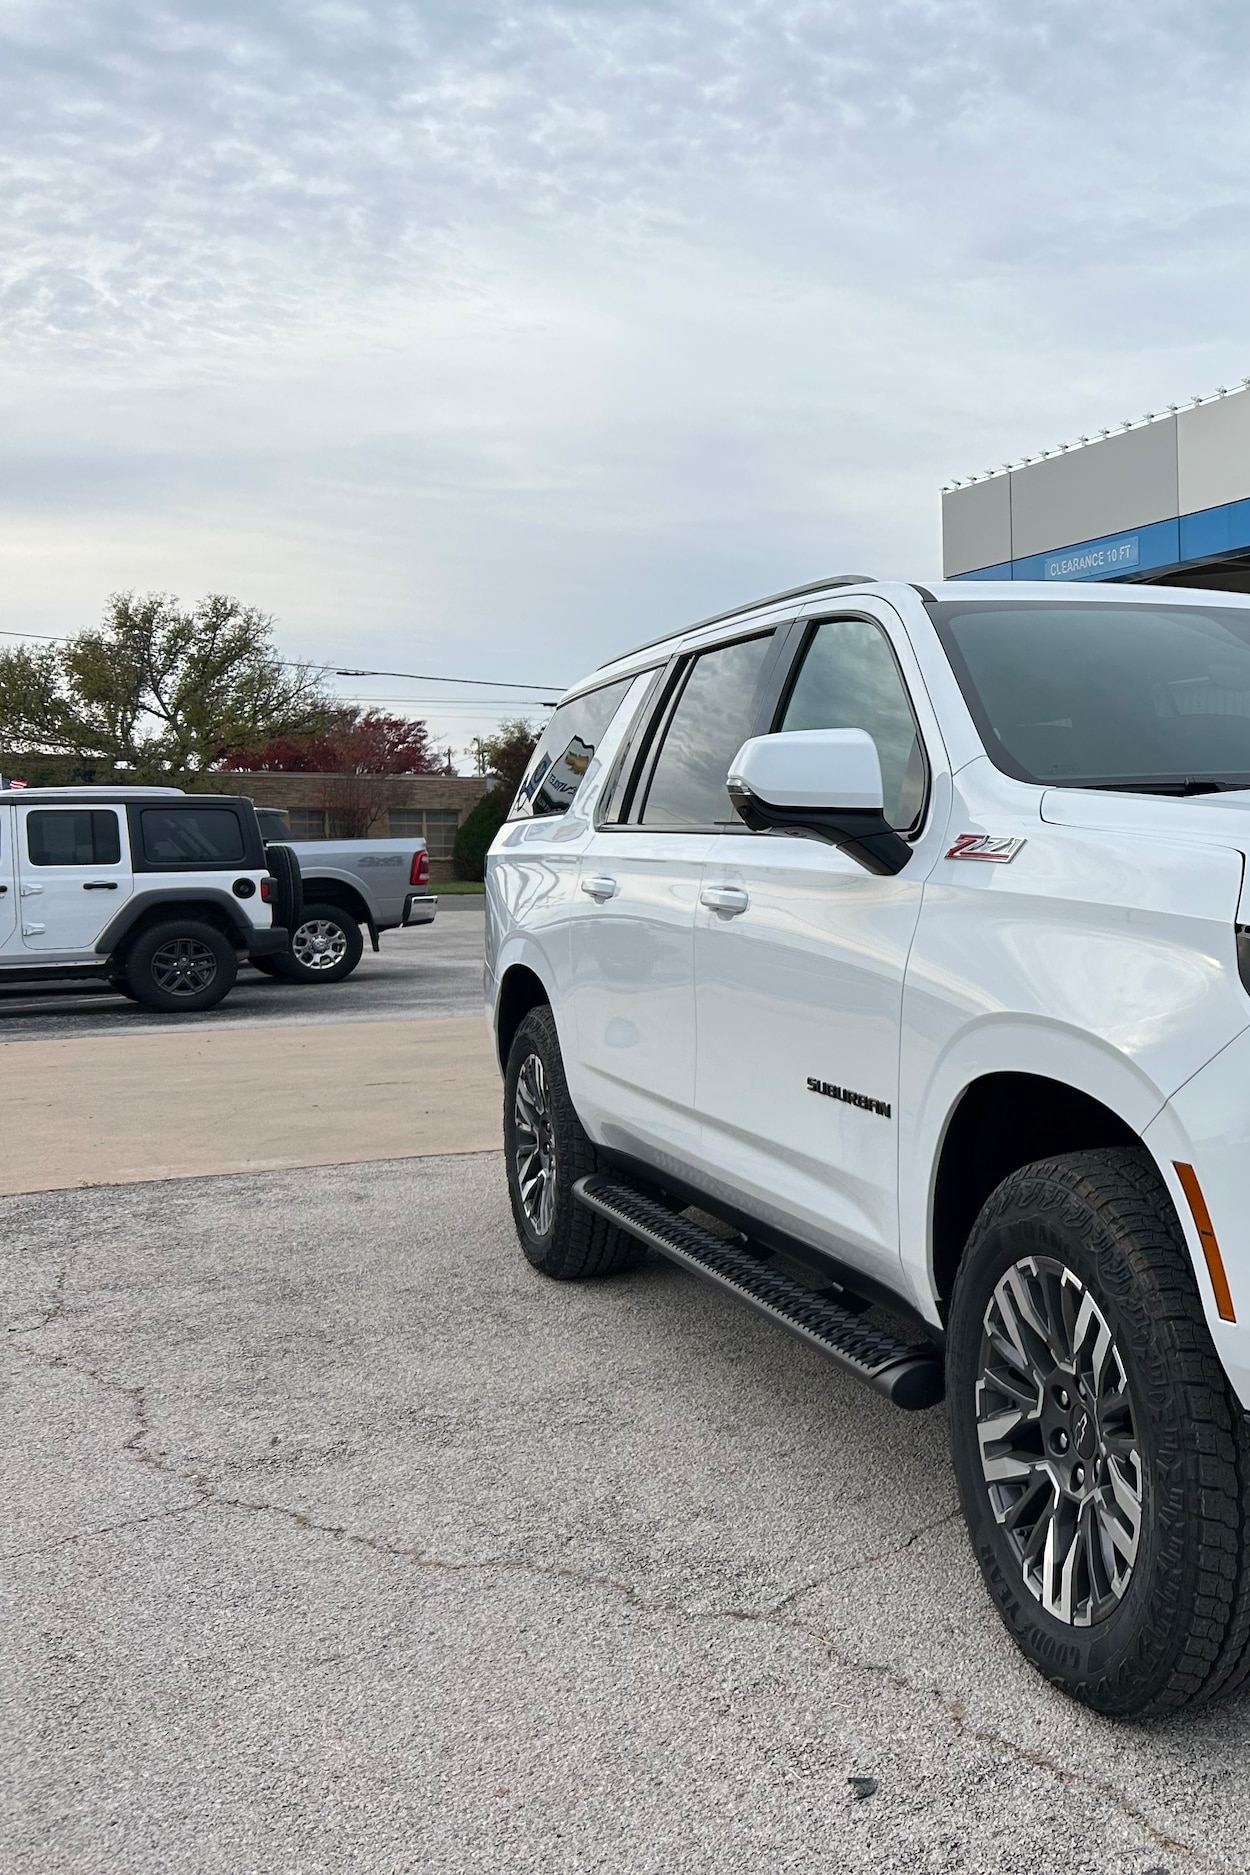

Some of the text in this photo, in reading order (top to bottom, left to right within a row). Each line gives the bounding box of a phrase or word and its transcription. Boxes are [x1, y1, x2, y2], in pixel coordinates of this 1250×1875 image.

[1050, 545, 1132, 577] CLEARANCE 10 FT
[943, 833, 1028, 864] Z71
[806, 1076, 892, 1120] SUBURBAN
